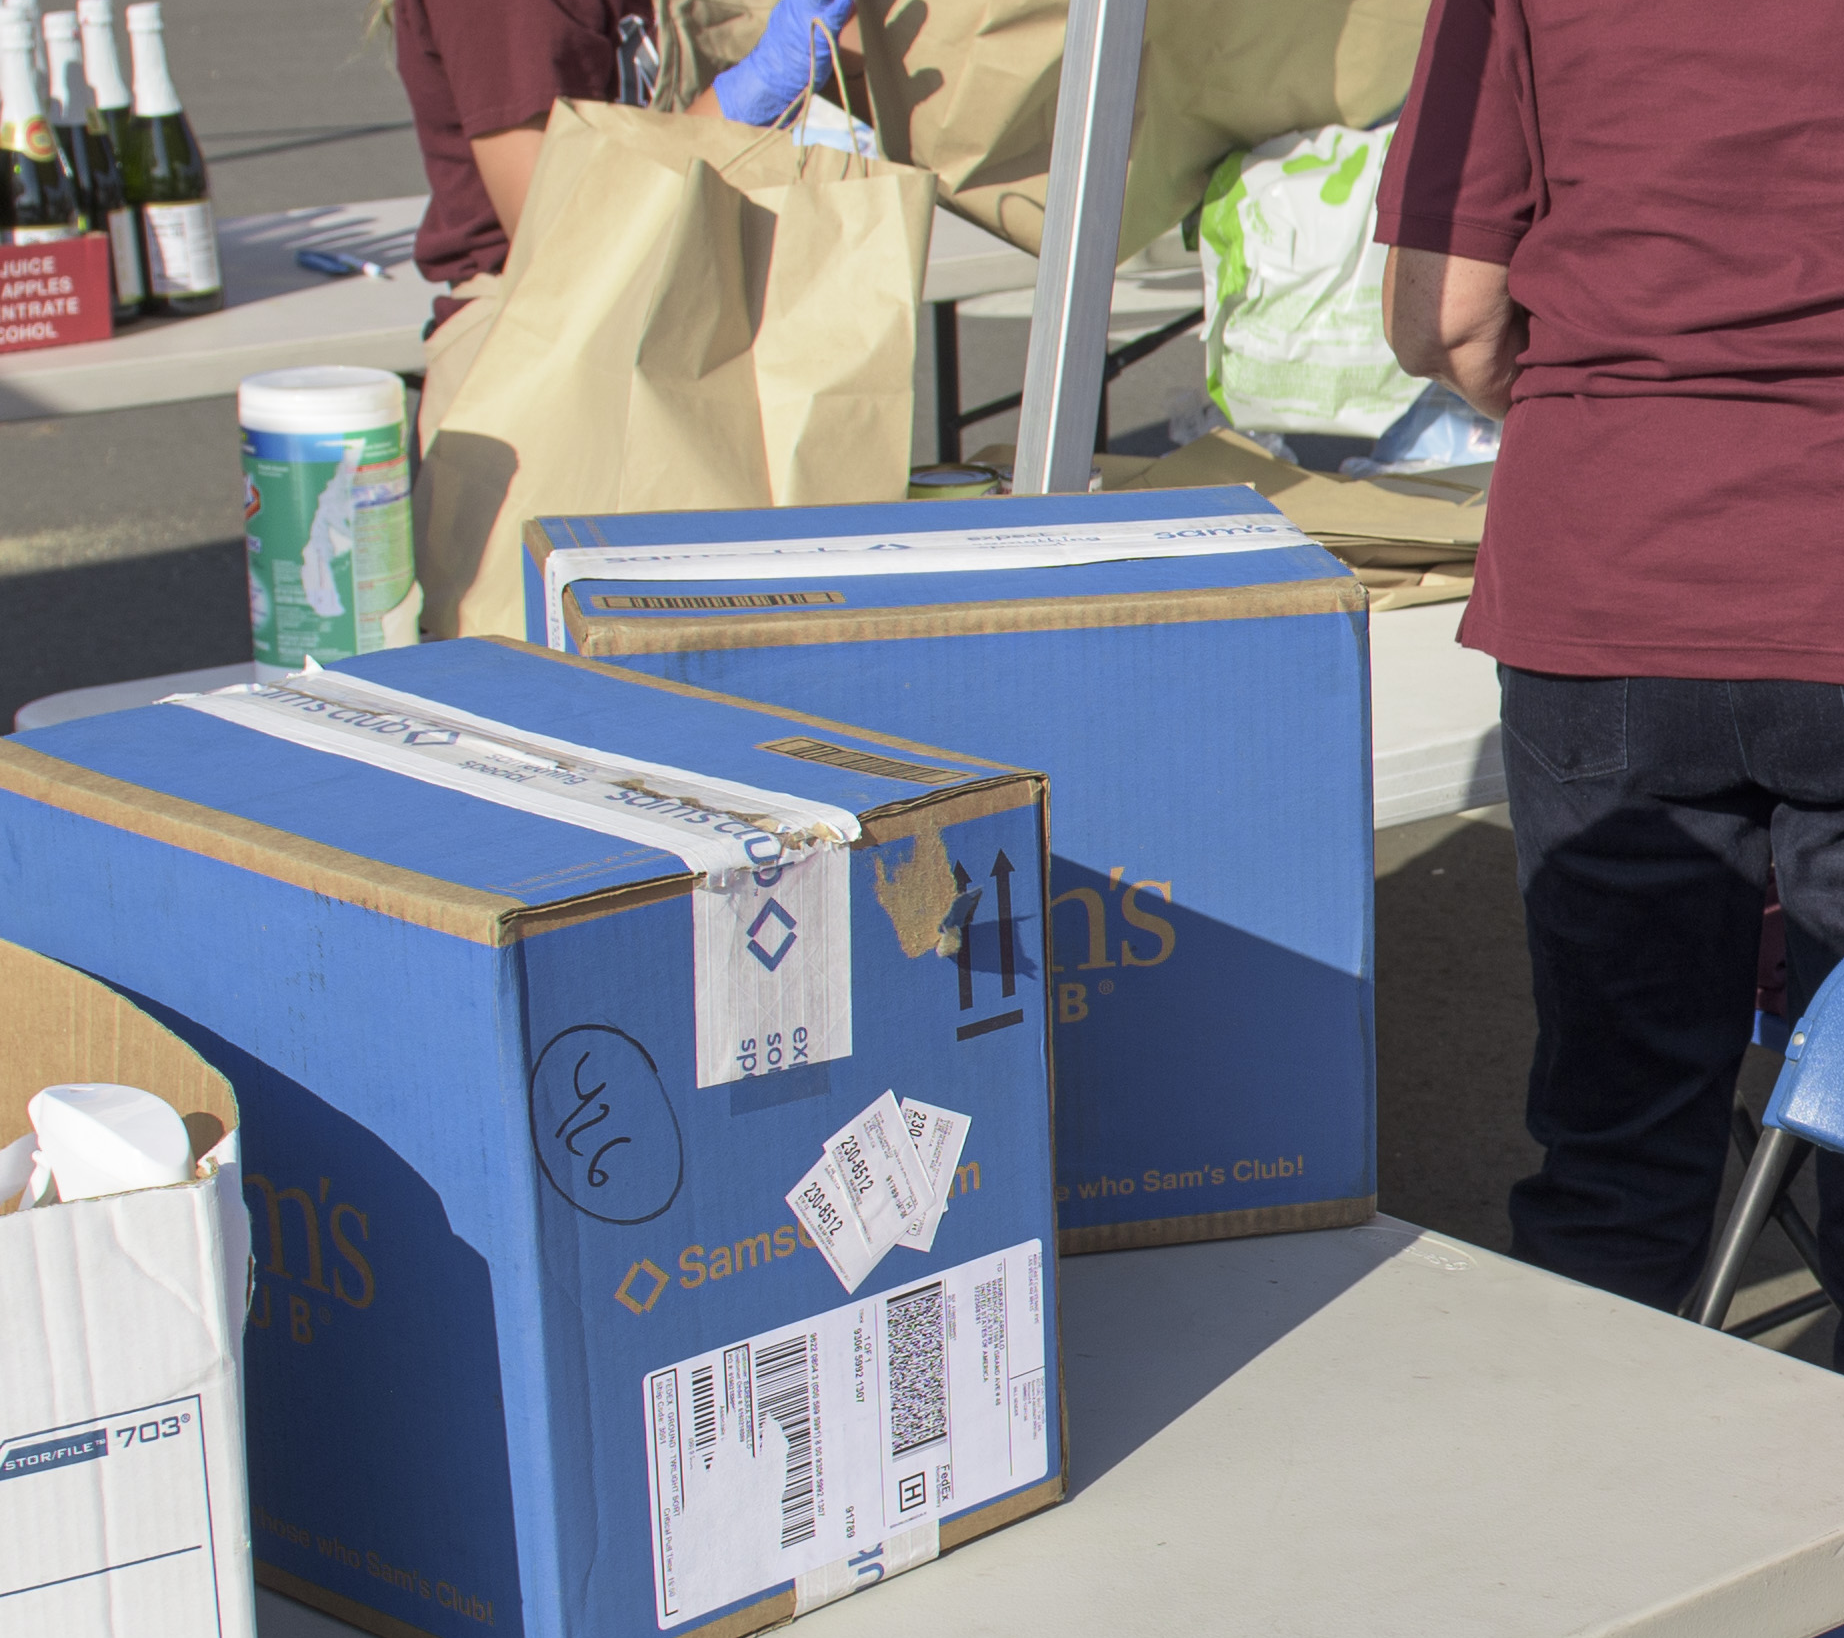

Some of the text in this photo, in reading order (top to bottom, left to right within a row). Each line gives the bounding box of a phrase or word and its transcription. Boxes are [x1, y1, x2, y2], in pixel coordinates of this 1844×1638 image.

[0, 255, 56, 277] JUICE
[2, 276, 73, 299] APPLES
[0, 297, 80, 321] NTRATE
[1154, 524, 1277, 540] sam's
[459, 759, 537, 783] special
[839, 1132, 875, 1195] 230-8512
[1079, 1170, 1136, 1200] who
[1143, 1163, 1225, 1193] Sam's
[1232, 1154, 1305, 1183] Club!
[802, 1180, 843, 1237] 230-8512
[852, 1327, 862, 1353] 9306
[981, 1338, 987, 1349] OF
[853, 1353, 863, 1379] 5992
[854, 1378, 864, 1405] 1307
[654, 1380, 664, 1401] Ship
[663, 1506, 673, 1536] Critical
[664, 1377, 680, 1518] FEDEX GROUND TWILIGHT SORT
[903, 1481, 922, 1503] H
[939, 1462, 951, 1502] FedEx
[844, 1504, 855, 1540] 91789
[316, 1533, 360, 1570] who
[366, 1550, 431, 1599] Sam's
[435, 1580, 496, 1626] Club!
